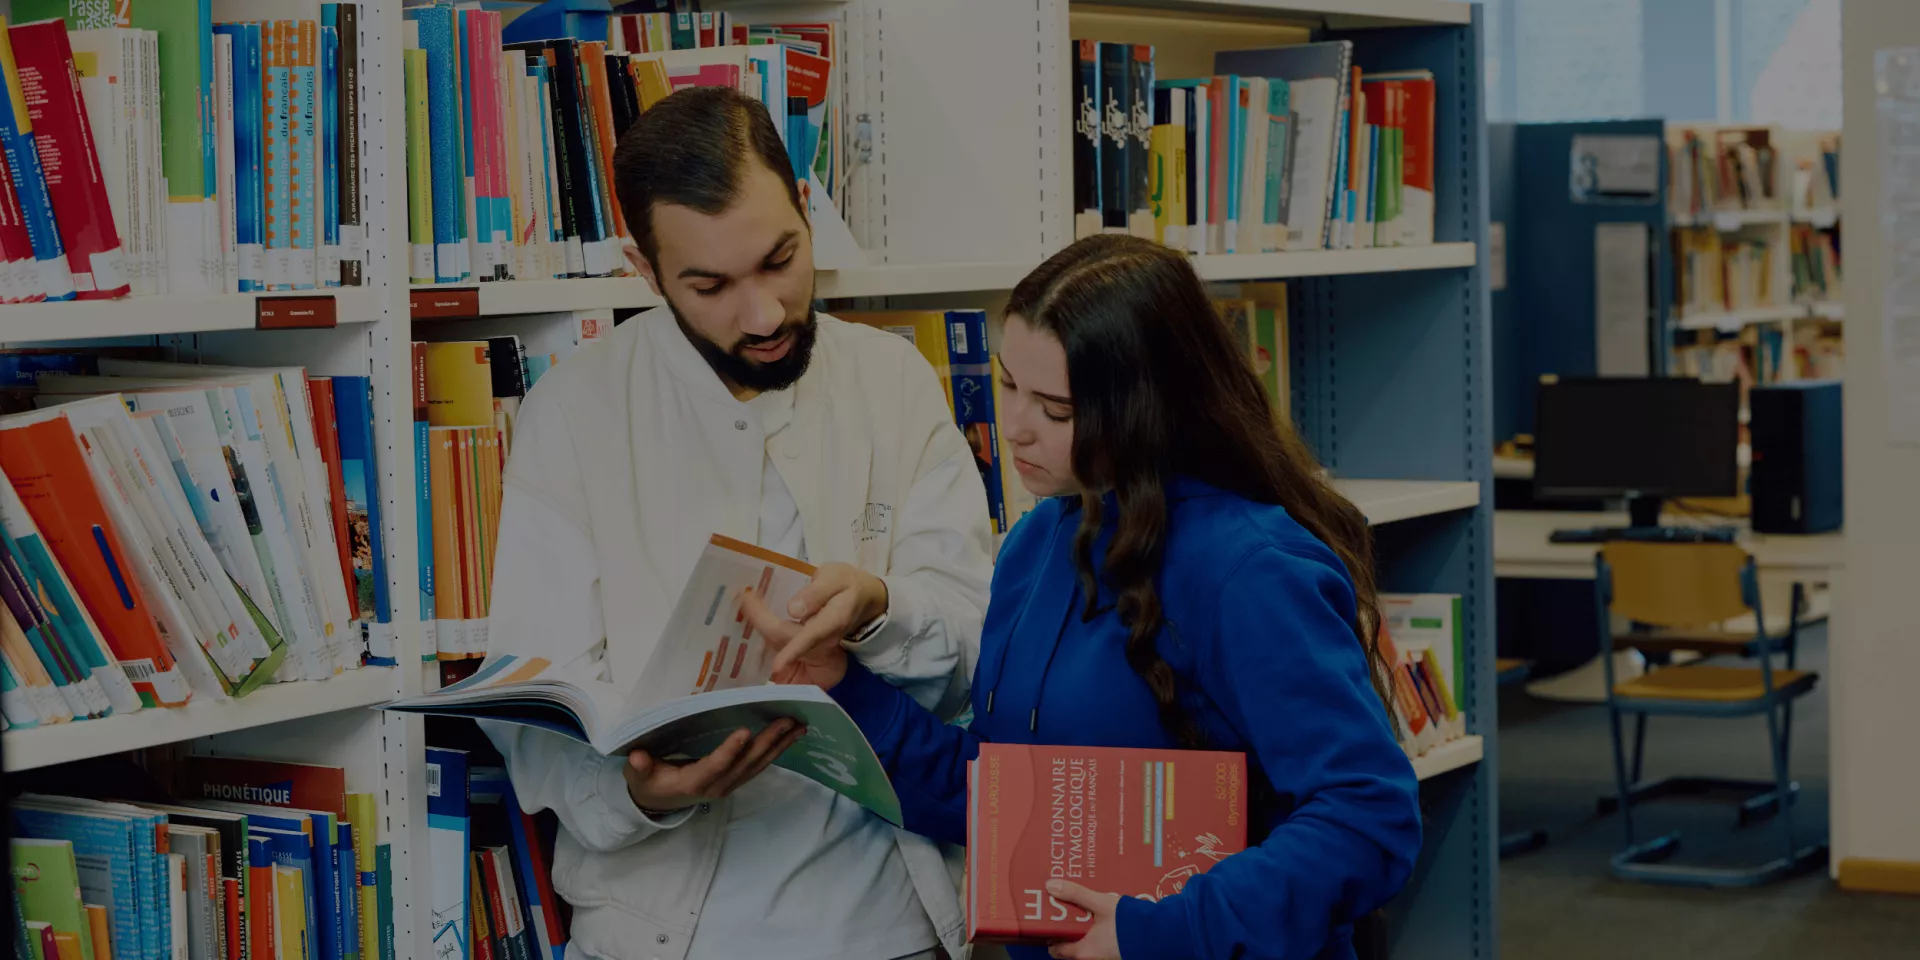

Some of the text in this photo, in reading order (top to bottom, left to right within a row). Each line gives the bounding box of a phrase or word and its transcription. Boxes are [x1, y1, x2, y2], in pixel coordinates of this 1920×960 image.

[69, 0, 110, 17] Passe
[116, 0, 130, 25] 2
[280, 71, 289, 119] français
[305, 71, 313, 119] français
[280, 122, 288, 137] du
[305, 122, 313, 136] du
[280, 203, 288, 248] mmaire
[305, 202, 313, 248] mmaire
[352, 213, 357, 223] LA
[203, 782, 291, 805] PHONÉTIQUE
[989, 755, 1000, 814] LAROUSSE
[1087, 758, 1098, 800] FRANÇAIS
[1226, 763, 1241, 826] étymologies
[1050, 757, 1066, 878] DICTIONNAIRE
[1066, 757, 1086, 878] ÉTYMOLOGIQUE
[1089, 802, 1095, 812] DU
[1087, 814, 1097, 868] HISTORIQUE
[203, 895, 209, 907] DU
[218, 892, 224, 904] DU
[333, 870, 341, 914] PHONÉTIQUE
[355, 874, 361, 886] DU
[238, 898, 244, 912] DU
[335, 915, 341, 923] DE
[356, 890, 364, 948] PROGRESSIVE
[204, 911, 213, 960] ROGRESSIVE
